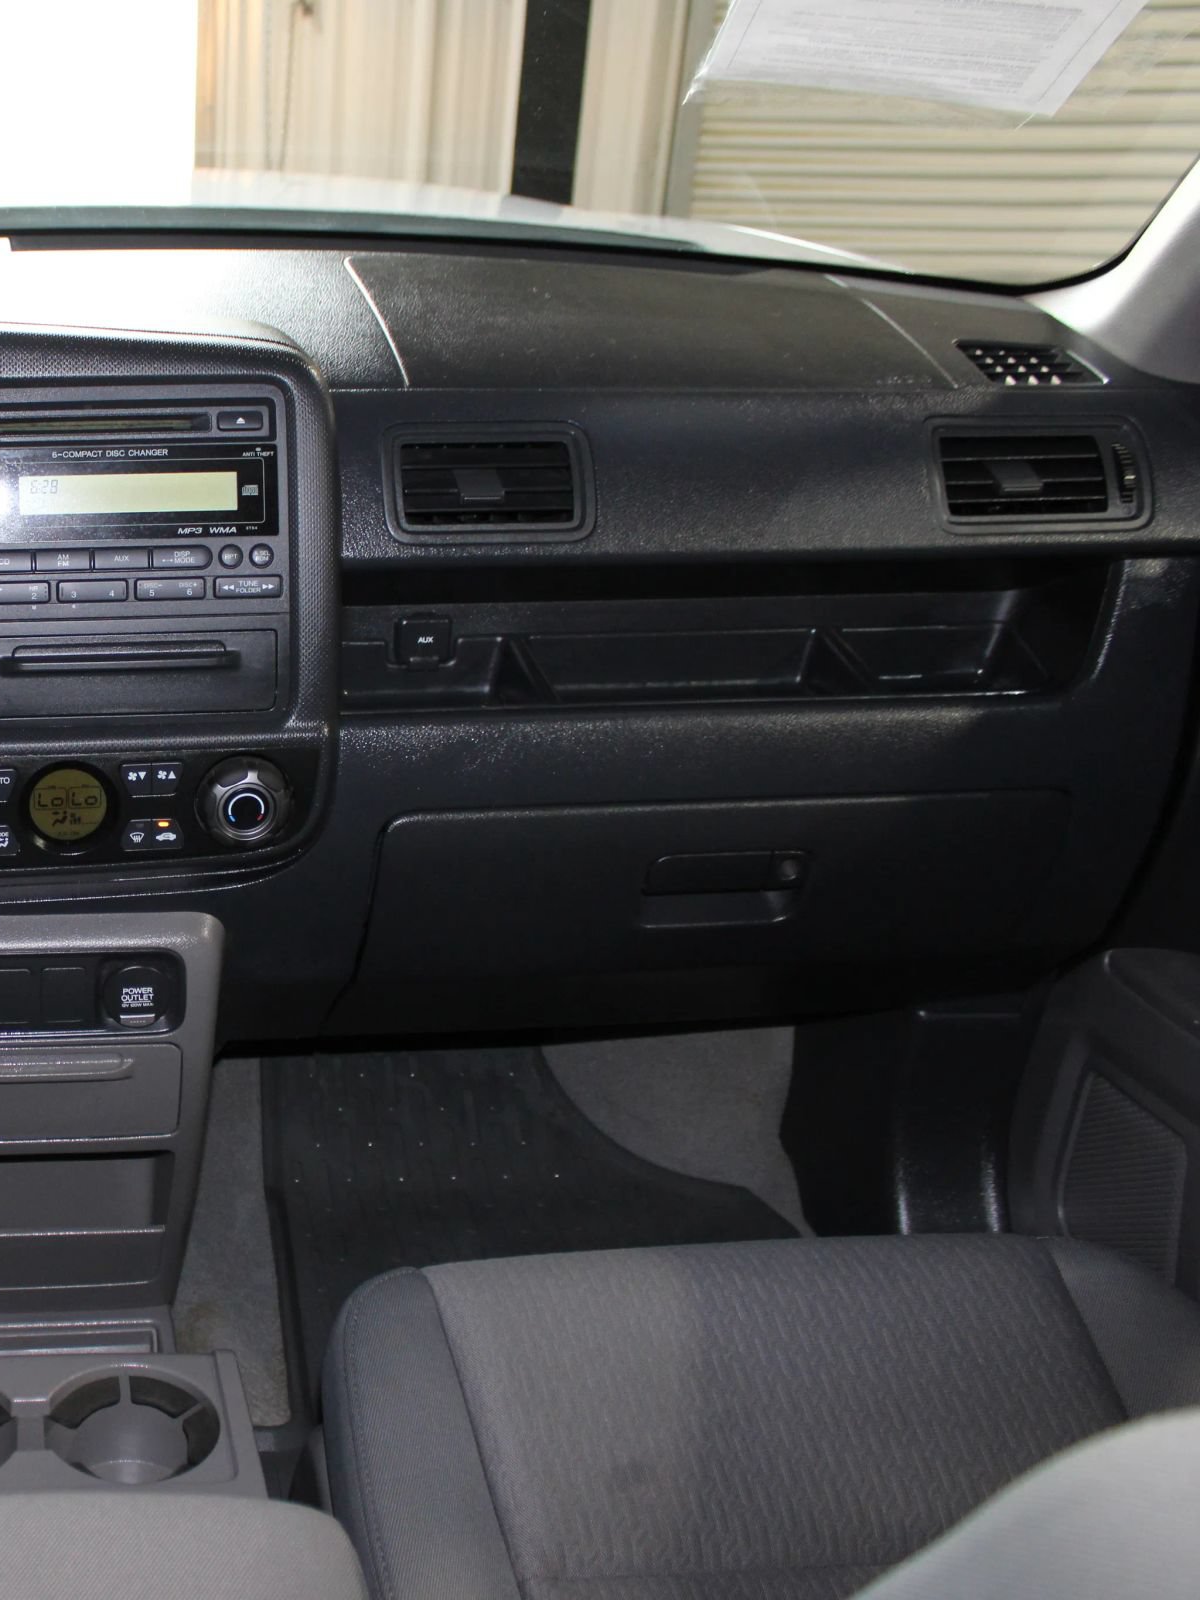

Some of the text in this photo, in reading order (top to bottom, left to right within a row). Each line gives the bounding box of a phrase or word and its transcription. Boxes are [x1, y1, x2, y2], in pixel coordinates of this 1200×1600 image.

[52, 450, 102, 459] 6-COMPACT
[209, 526, 237, 534] WMA
[149, 589, 155, 597] 5
[186, 588, 193, 596] 6
[418, 636, 433, 644] AUX
[121, 994, 154, 1002] OUTLET
